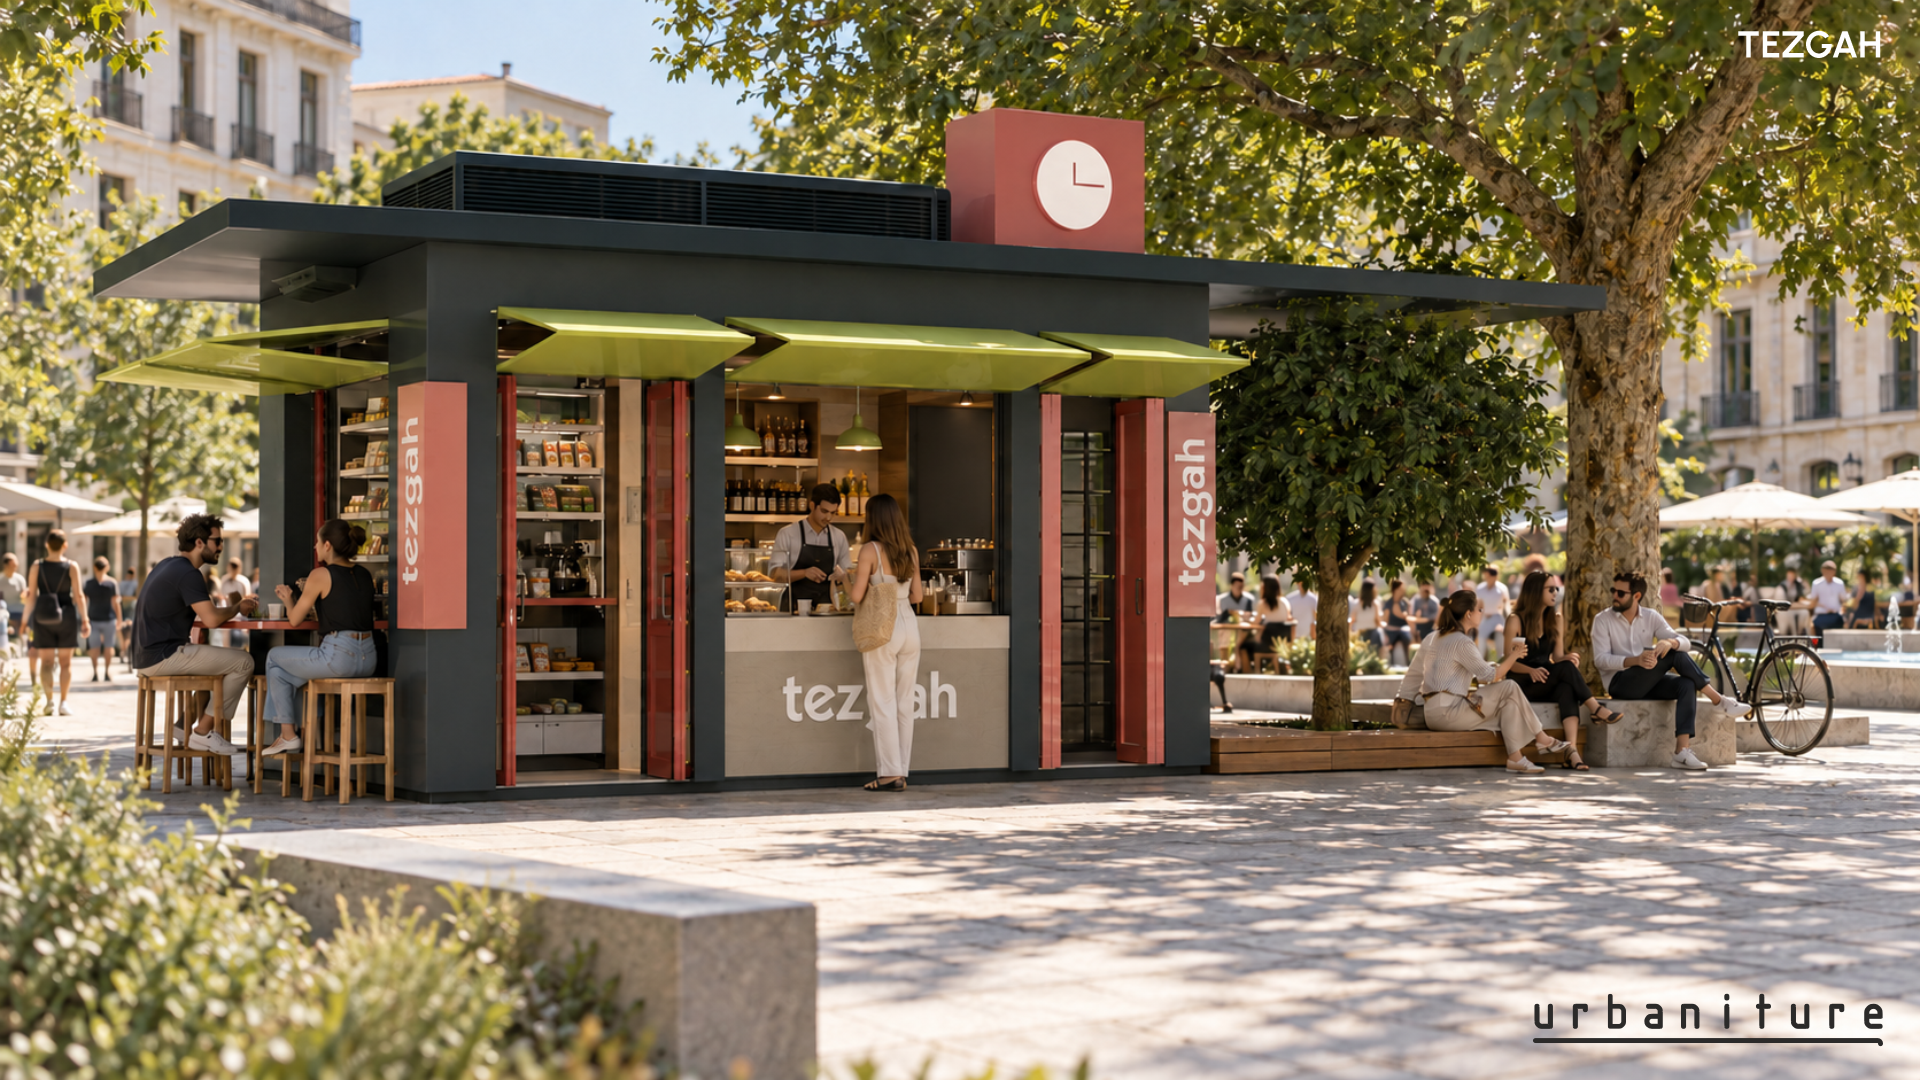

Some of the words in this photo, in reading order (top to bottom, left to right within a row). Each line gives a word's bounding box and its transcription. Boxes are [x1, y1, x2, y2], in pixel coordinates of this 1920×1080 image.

[401, 417, 423, 585] tezgah
[1174, 439, 1214, 586] tezgah
[782, 670, 957, 732] tezah
